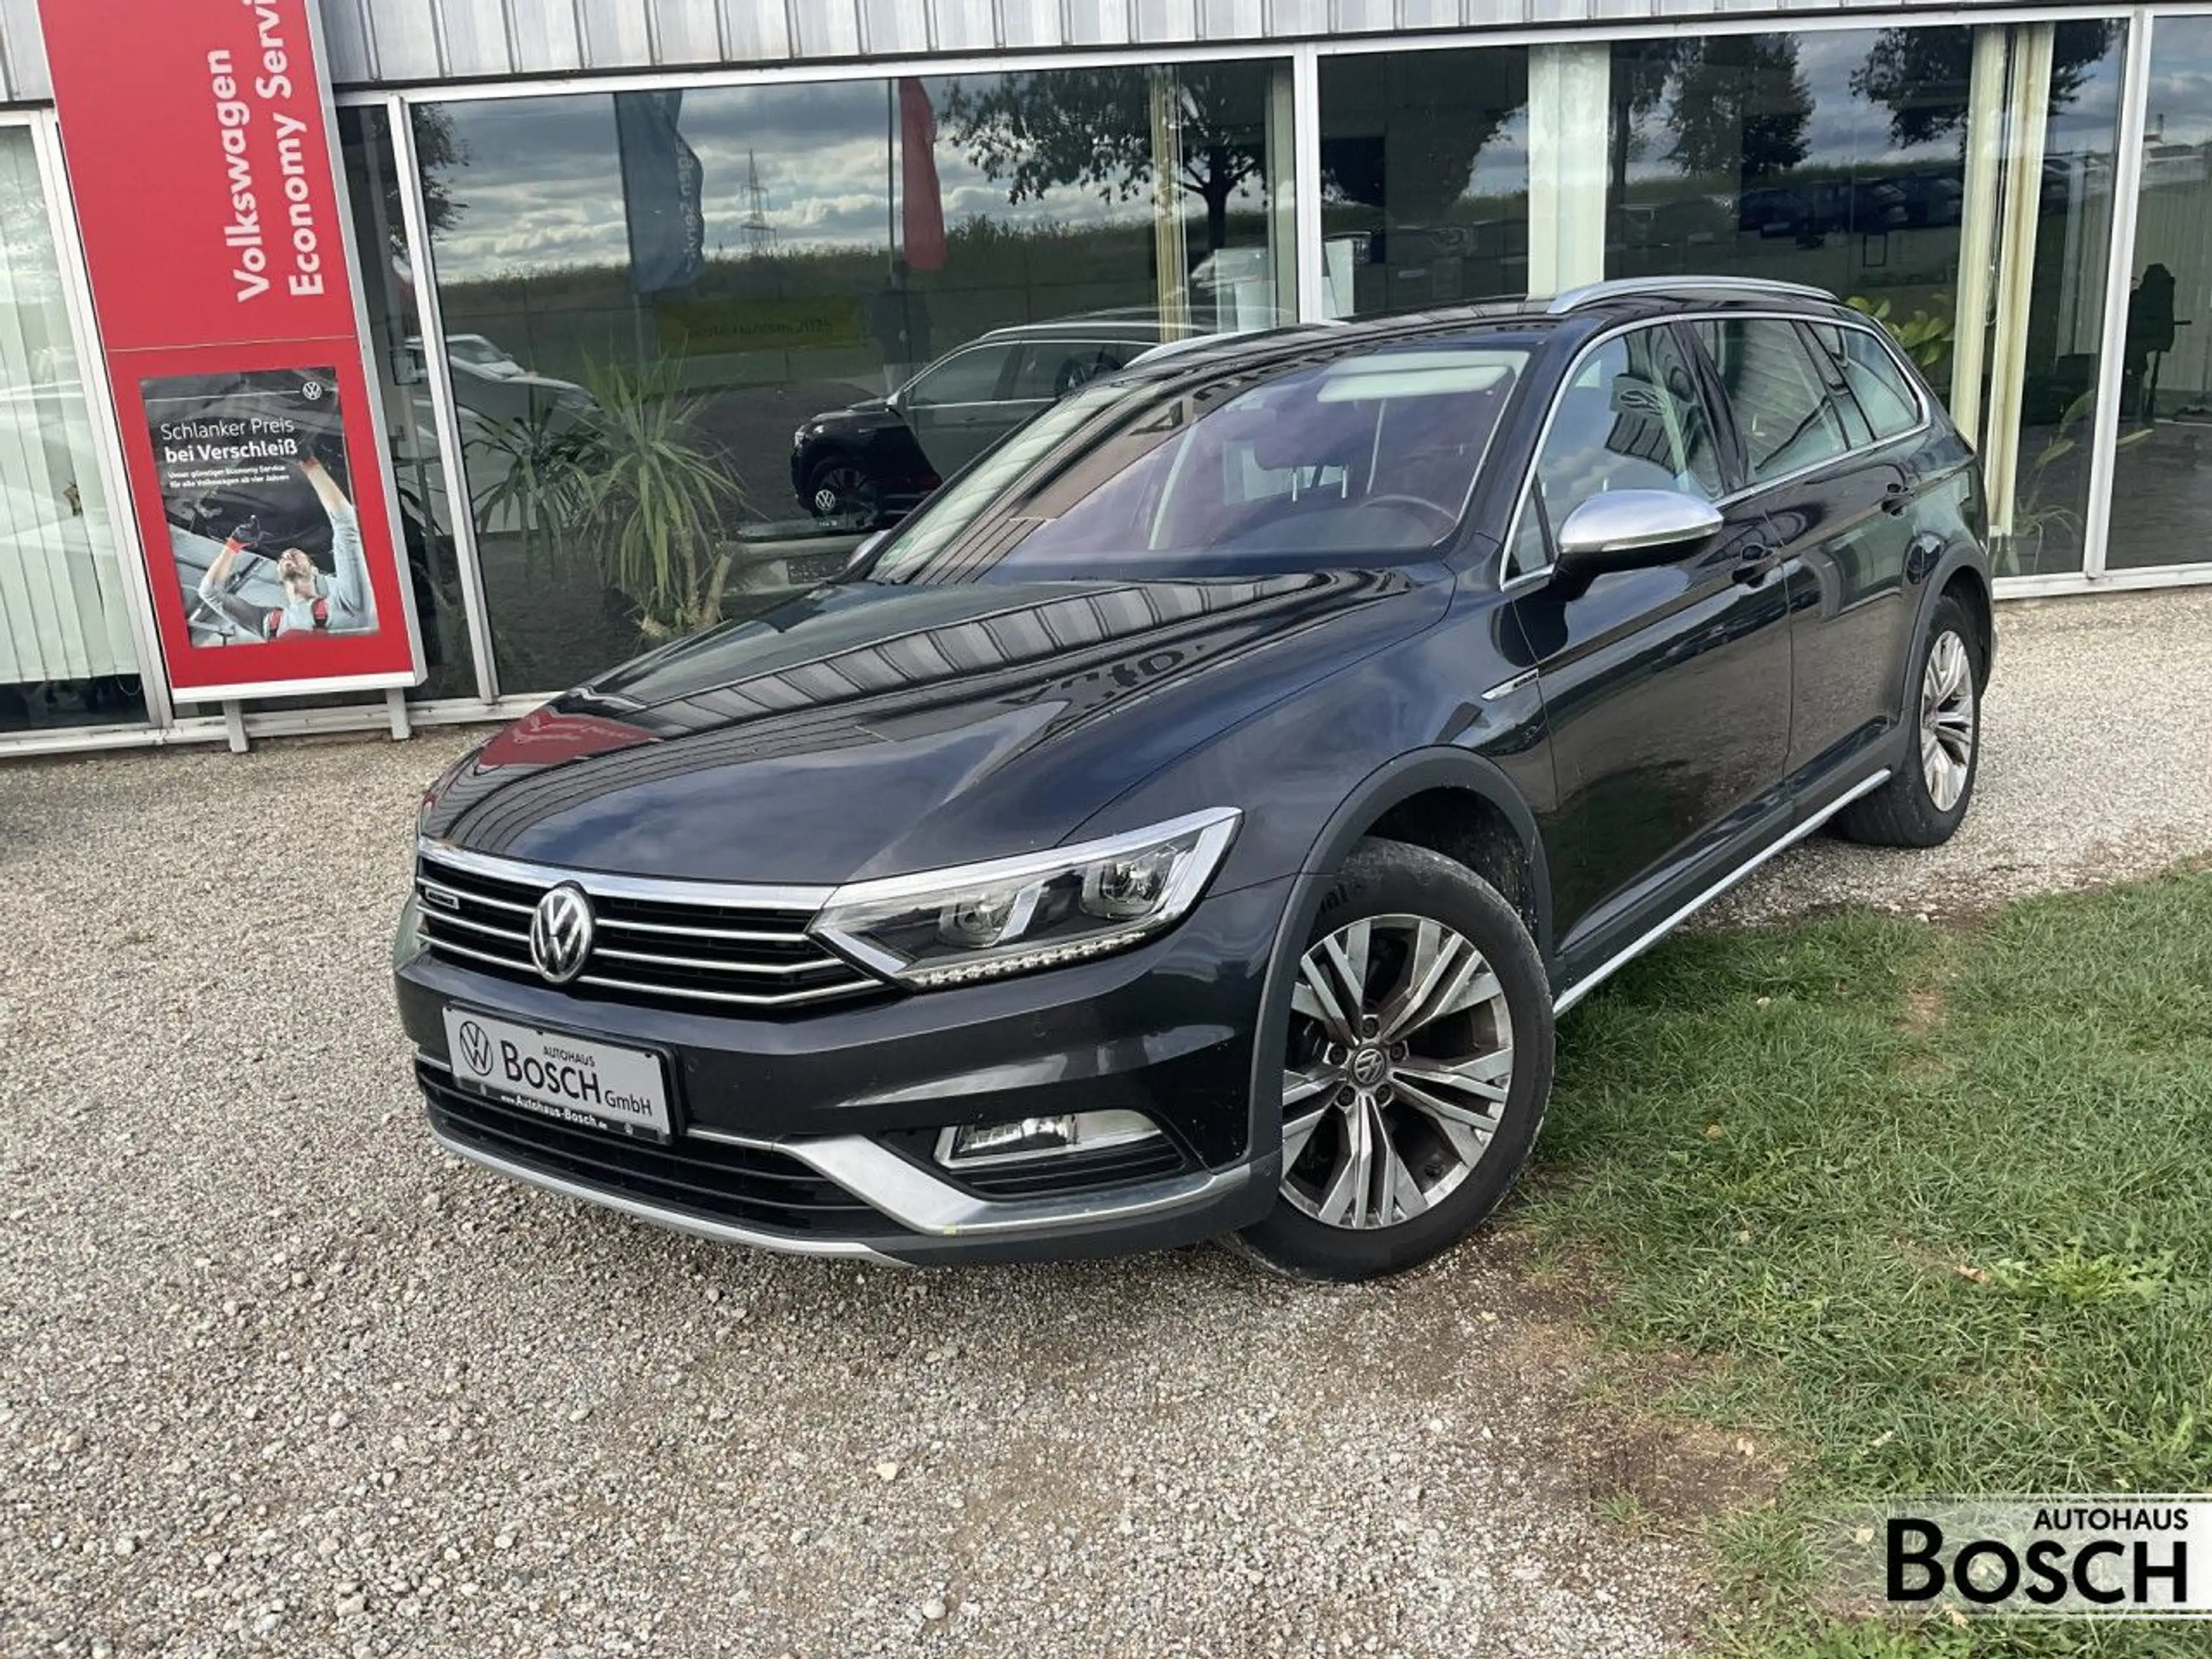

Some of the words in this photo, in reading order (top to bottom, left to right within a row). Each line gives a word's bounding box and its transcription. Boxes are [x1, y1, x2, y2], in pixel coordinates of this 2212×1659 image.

[208, 49, 270, 302] Volkswagen
[272, 112, 324, 296] Economy
[160, 419, 246, 440] Schlanker
[250, 416, 295, 434] Preis
[164, 445, 195, 464] bei
[196, 438, 298, 461] Verschleiß
[500, 1039, 602, 1105] BOSCH
[604, 1089, 653, 1117] GmbH
[543, 1045, 596, 1067] AUTOHAUS
